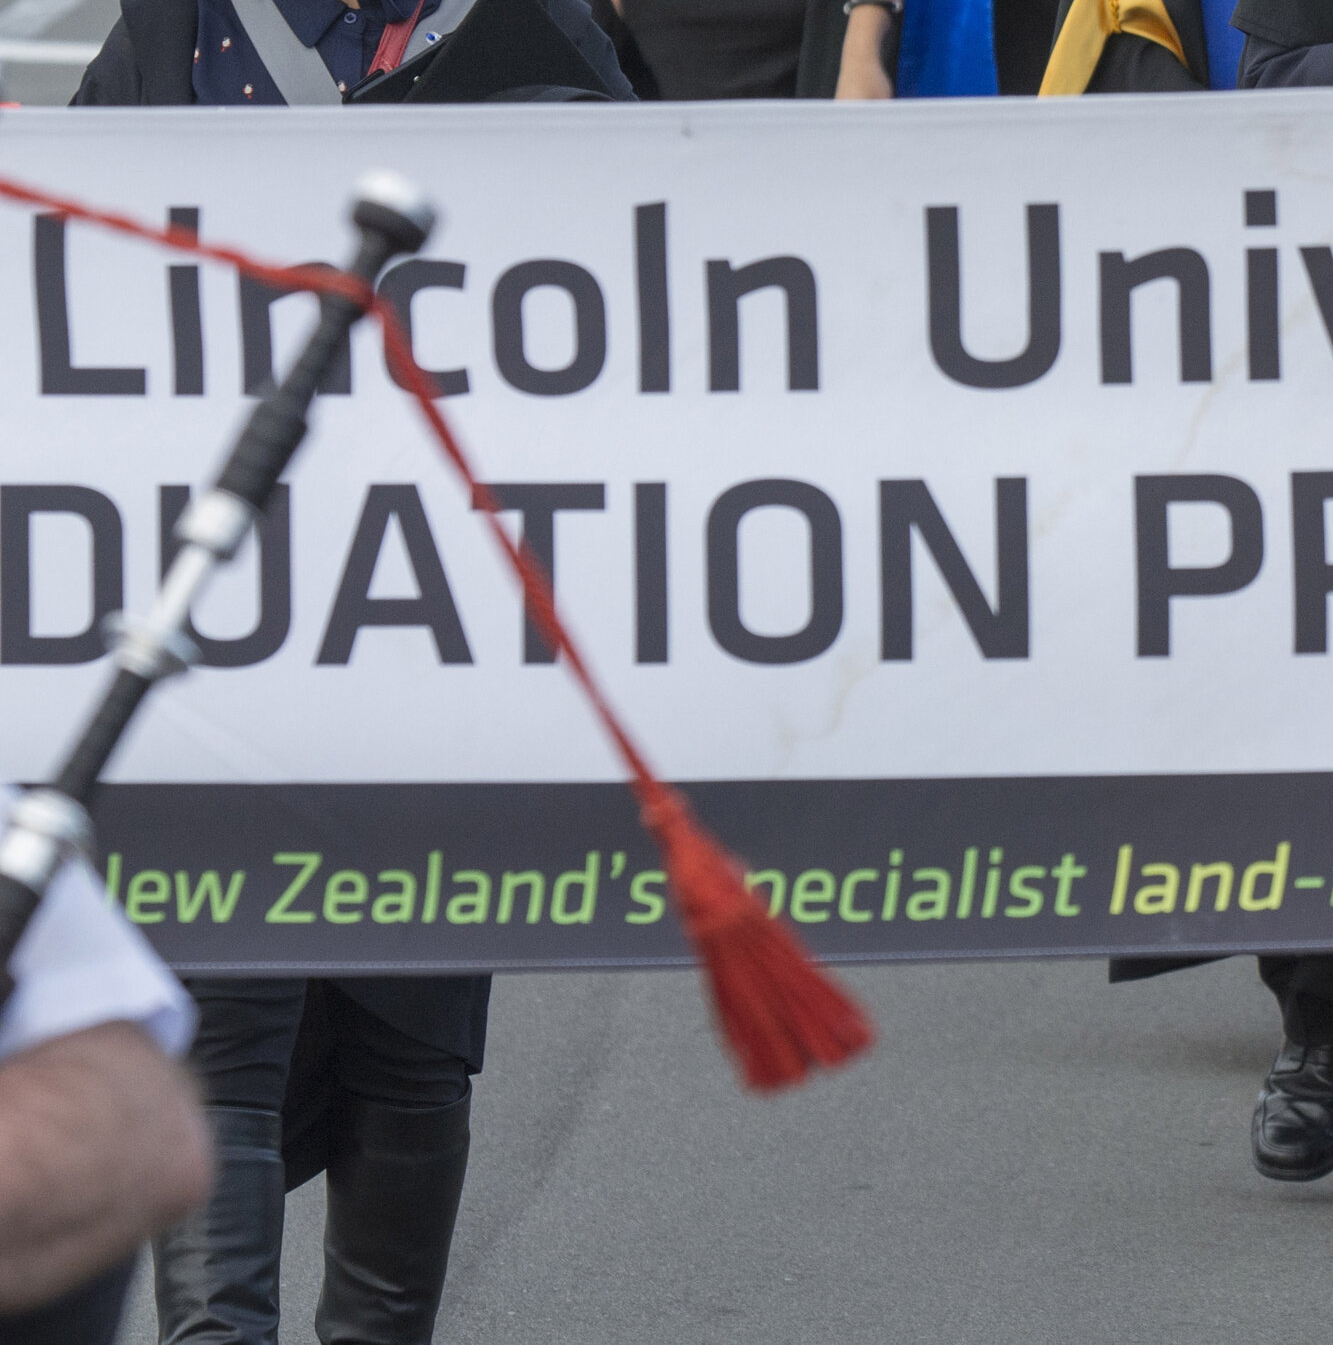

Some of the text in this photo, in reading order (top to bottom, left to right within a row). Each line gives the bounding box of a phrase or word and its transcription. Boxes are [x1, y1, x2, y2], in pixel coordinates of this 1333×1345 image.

[33, 202, 821, 398] Lincoln
[265, 849, 669, 926] Zealand's
[742, 845, 1088, 924] pecialist
